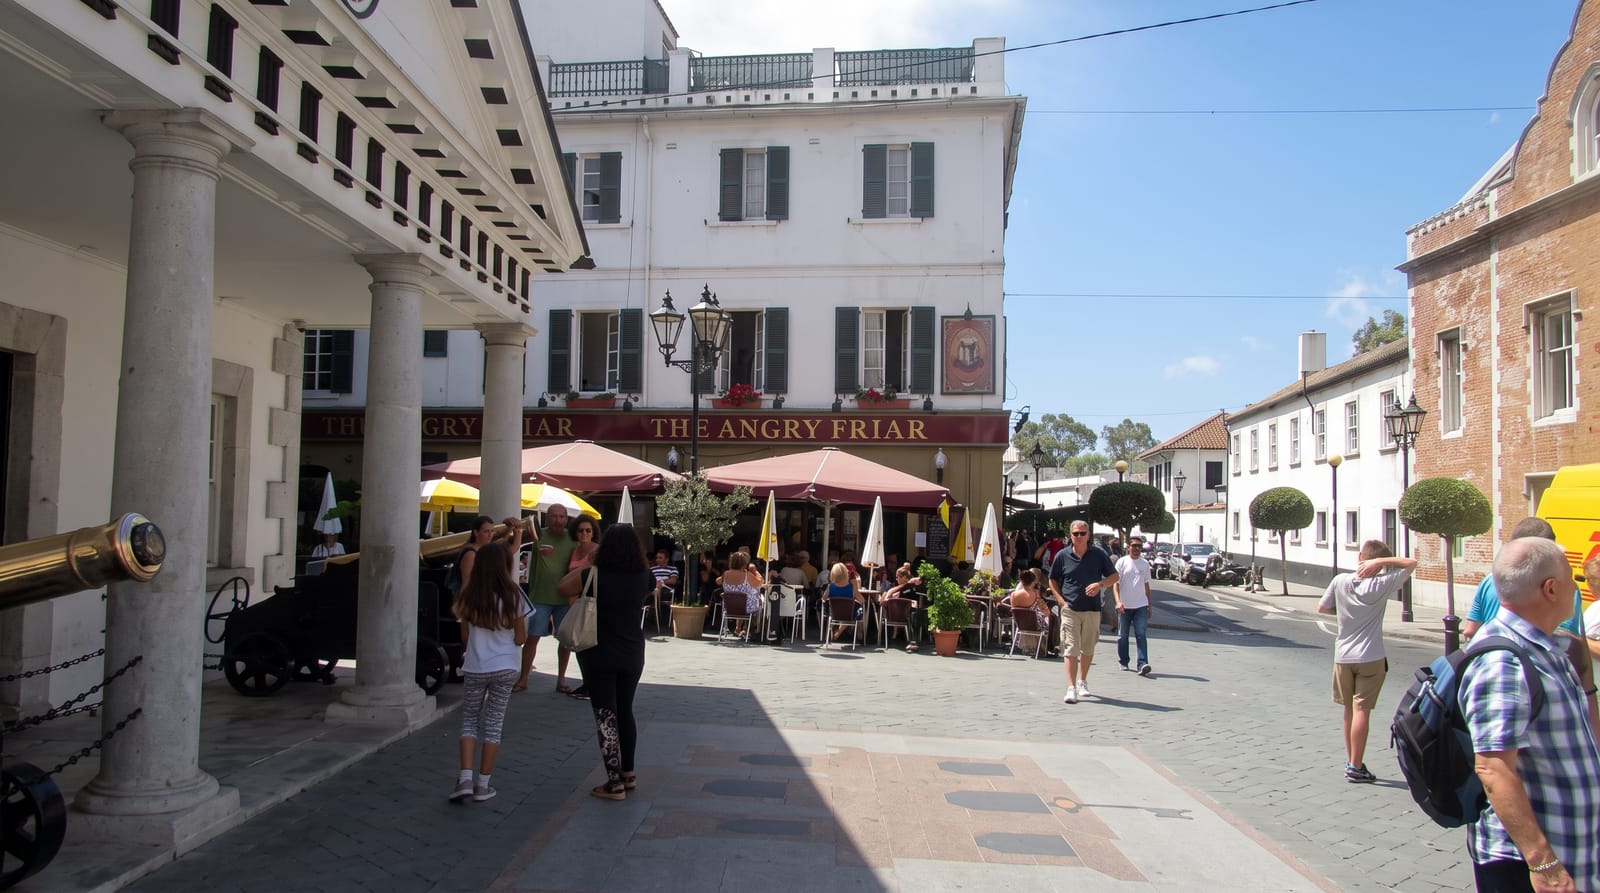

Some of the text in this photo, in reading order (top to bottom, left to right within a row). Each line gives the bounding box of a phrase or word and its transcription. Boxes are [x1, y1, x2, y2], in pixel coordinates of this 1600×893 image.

[422, 417, 477, 436] GRY
[523, 417, 575, 437] IAR
[650, 418, 928, 440] THE ANGRY FRIAR
